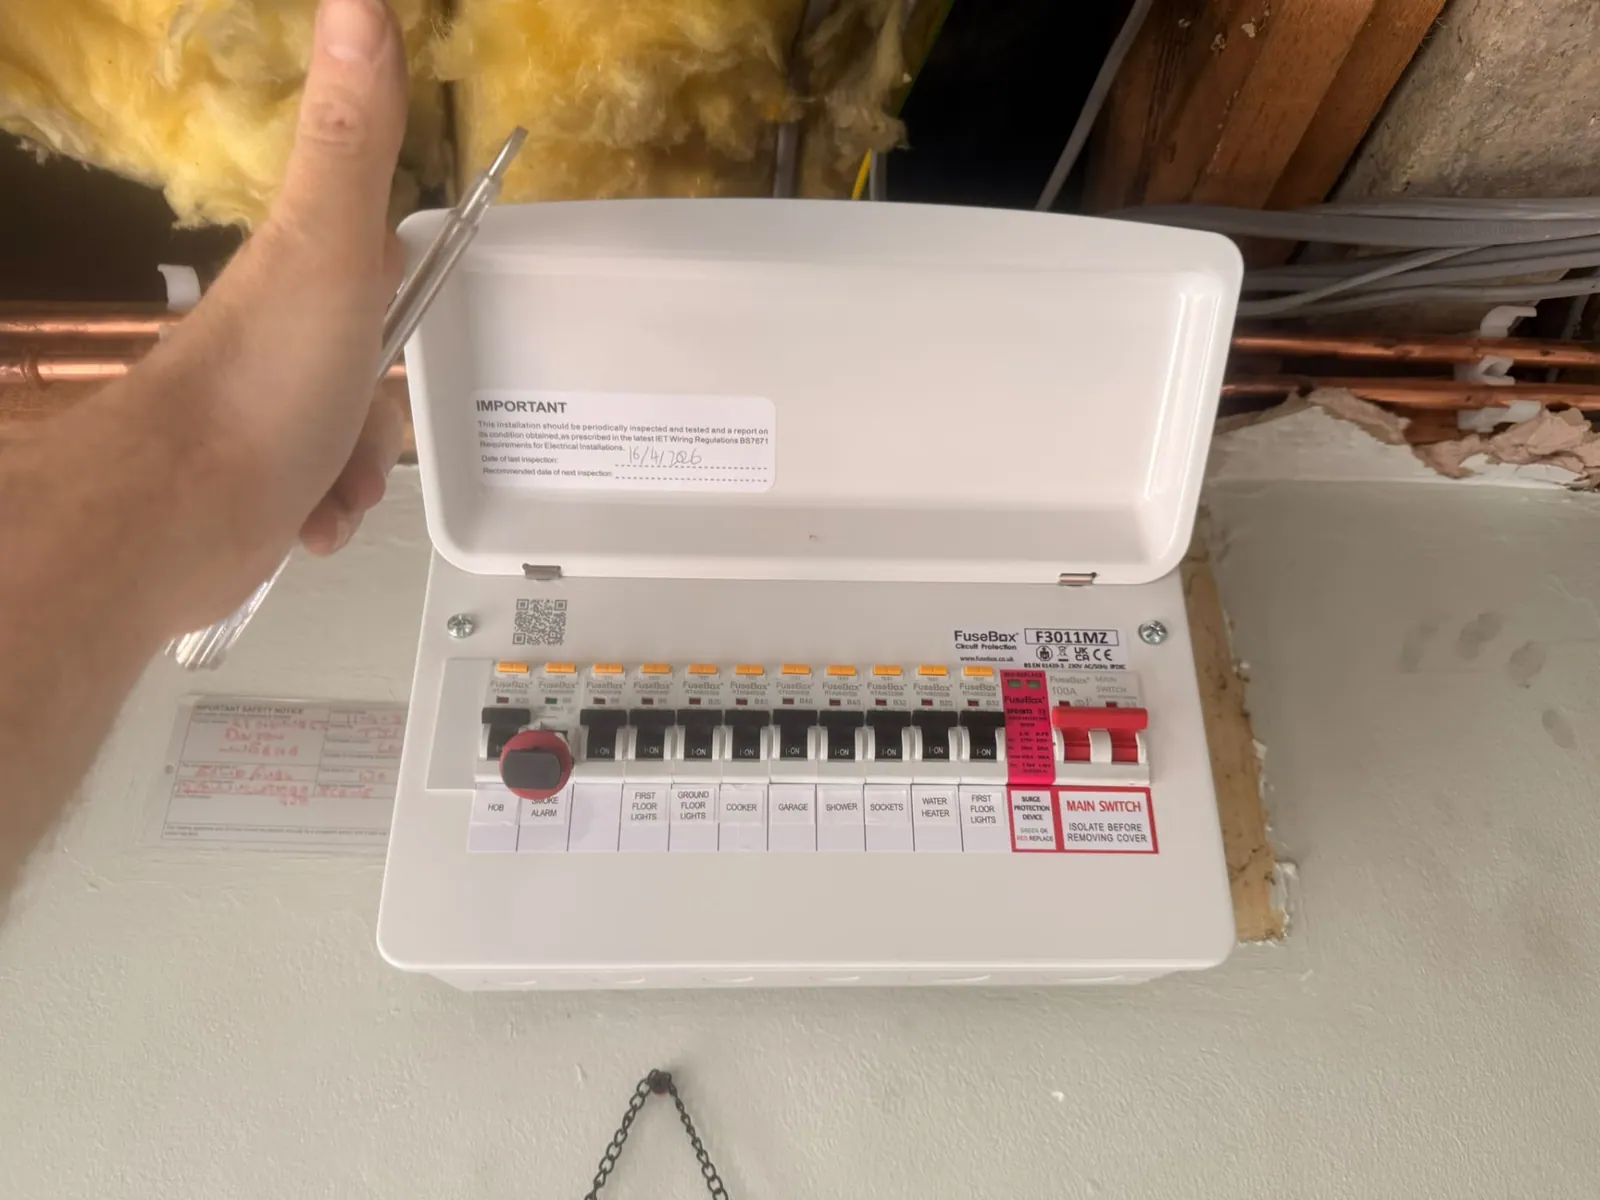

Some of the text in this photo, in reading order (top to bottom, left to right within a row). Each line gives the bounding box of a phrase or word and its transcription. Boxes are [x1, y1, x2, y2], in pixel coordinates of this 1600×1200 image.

[476, 399, 567, 413] IMPORTANT
[478, 420, 495, 428] This
[496, 421, 541, 429] installation
[542, 422, 569, 430] should
[582, 424, 627, 433] periodically
[629, 425, 667, 434] inspected
[685, 426, 709, 434] tested
[733, 427, 757, 436] report
[487, 431, 525, 439] condition
[571, 433, 611, 442] prescribed
[612, 433, 619, 441] in
[620, 433, 632, 441] the
[633, 434, 654, 442] latest
[669, 435, 693, 444] Wiring
[694, 436, 738, 445] Regulations
[740, 437, 768, 445] BS7671
[480, 440, 532, 449] Requirements
[533, 441, 543, 449] for
[481, 454, 498, 462] Date
[483, 467, 536, 475] Recommended
[537, 468, 553, 476] date
[553, 468, 560, 476] of
[954, 630, 1017, 642] FuseBox
[1036, 631, 1108, 644] F3011MZ
[981, 643, 1017, 651] Protection
[960, 655, 1015, 663] www.fusebox.co.uk
[1051, 686, 1077, 695] 100A
[1096, 685, 1127, 693] SWITCH
[634, 791, 656, 800] FIRST
[677, 790, 709, 799] GROUND
[971, 794, 991, 803] FIRST
[680, 801, 706, 810] FLOOR
[922, 797, 947, 806] WATER
[487, 803, 505, 812] HOB
[632, 802, 657, 811] FLOOR
[726, 803, 757, 812] COOKER
[778, 803, 808, 812] GARAGE
[826, 803, 858, 812] SHOWER
[870, 803, 904, 812] SOCKETS
[970, 804, 995, 813] FLOOR
[1014, 804, 1050, 812] PROTECTION
[1066, 800, 1142, 813] MAIN SWITCH
[531, 808, 557, 817] ALARM
[631, 812, 657, 821] LIGHTS
[680, 812, 706, 820] LIGHTS
[921, 809, 950, 818] HEATER
[970, 815, 996, 824] LIGHTS
[1068, 822, 1143, 832] ISOLATE BEFORE
[1067, 833, 1148, 843] REMOVING COVER
